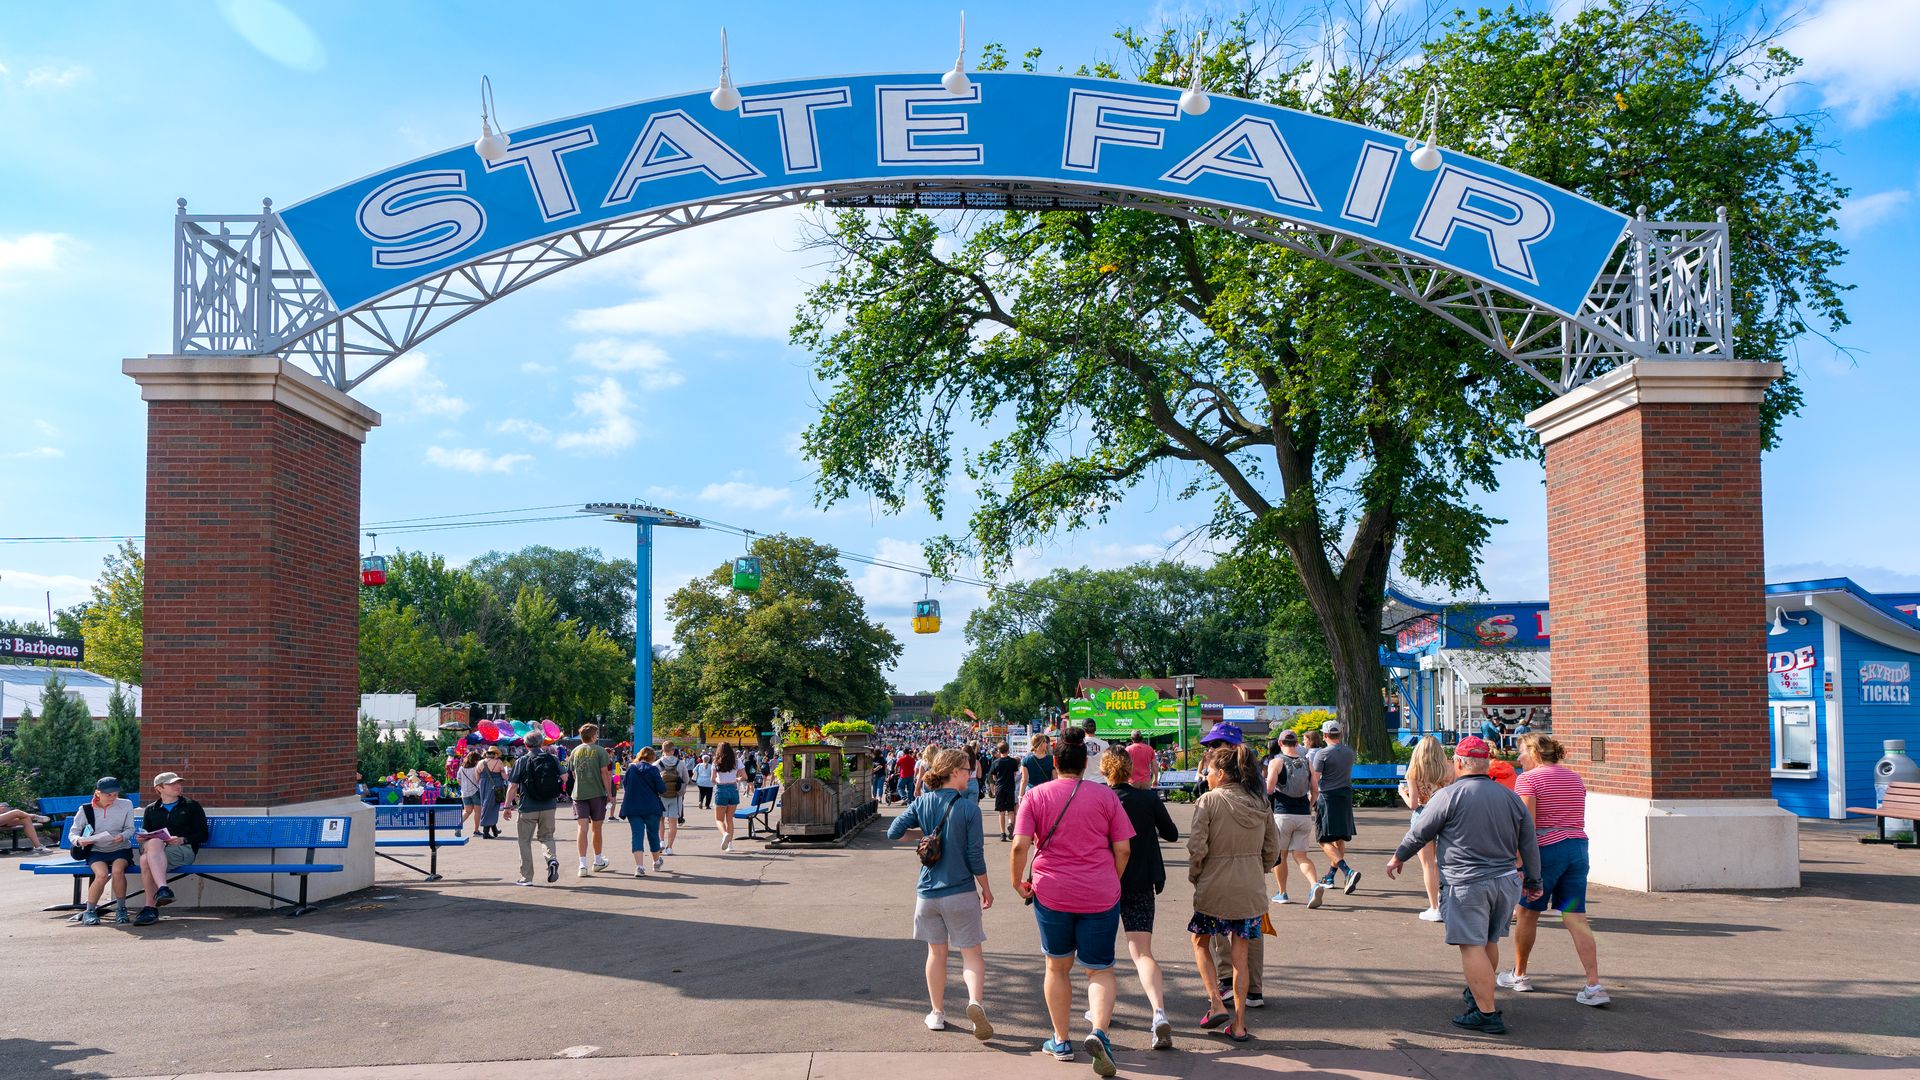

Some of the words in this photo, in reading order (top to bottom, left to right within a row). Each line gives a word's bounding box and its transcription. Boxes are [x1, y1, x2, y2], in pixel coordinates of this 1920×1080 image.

[355, 84, 985, 270] STATE
[1061, 88, 1556, 286] FAIR
[14, 637, 79, 657] Barbecue
[1860, 663, 1911, 685] SKYRIDE
[1111, 691, 1141, 701] FRIED
[1862, 685, 1910, 703] TICKETS
[1105, 700, 1147, 711] PICKLES
